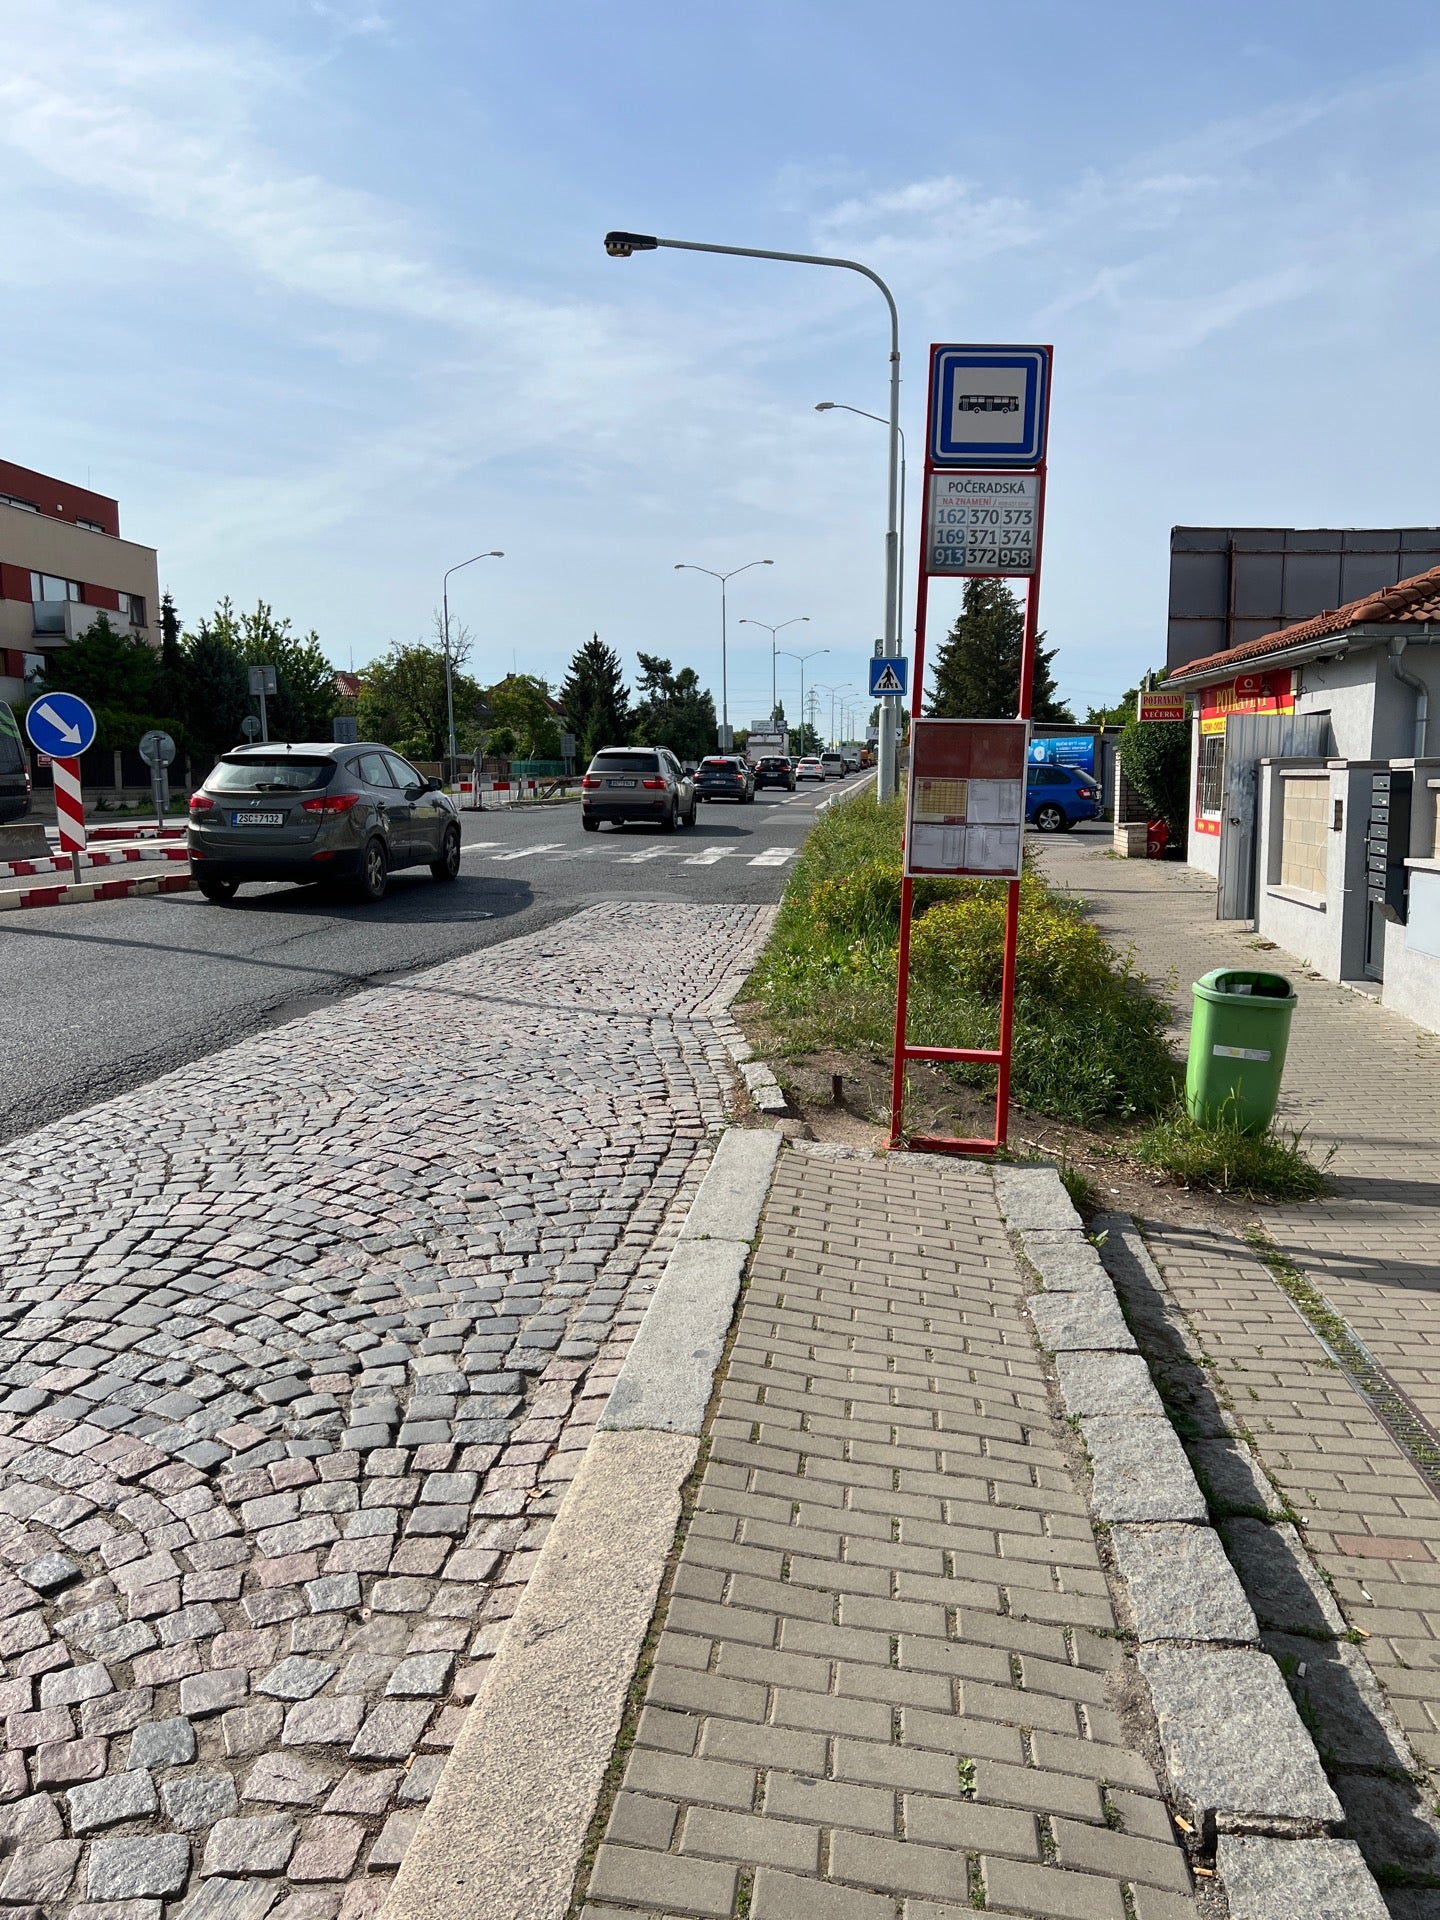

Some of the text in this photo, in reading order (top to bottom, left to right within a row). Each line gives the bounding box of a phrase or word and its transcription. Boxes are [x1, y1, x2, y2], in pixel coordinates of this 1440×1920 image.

[948, 480, 1025, 494] POČERADSKÁ
[955, 497, 992, 506] ZNAMENÍ
[938, 509, 1033, 524] 162 370 373
[937, 529, 1031, 546] 169 371 374
[935, 549, 1030, 566] 913 372 958
[1143, 695, 1183, 705] POTRAVINY
[1144, 710, 1180, 718] VEČERKA
[238, 814, 279, 823] 2SC 7132
